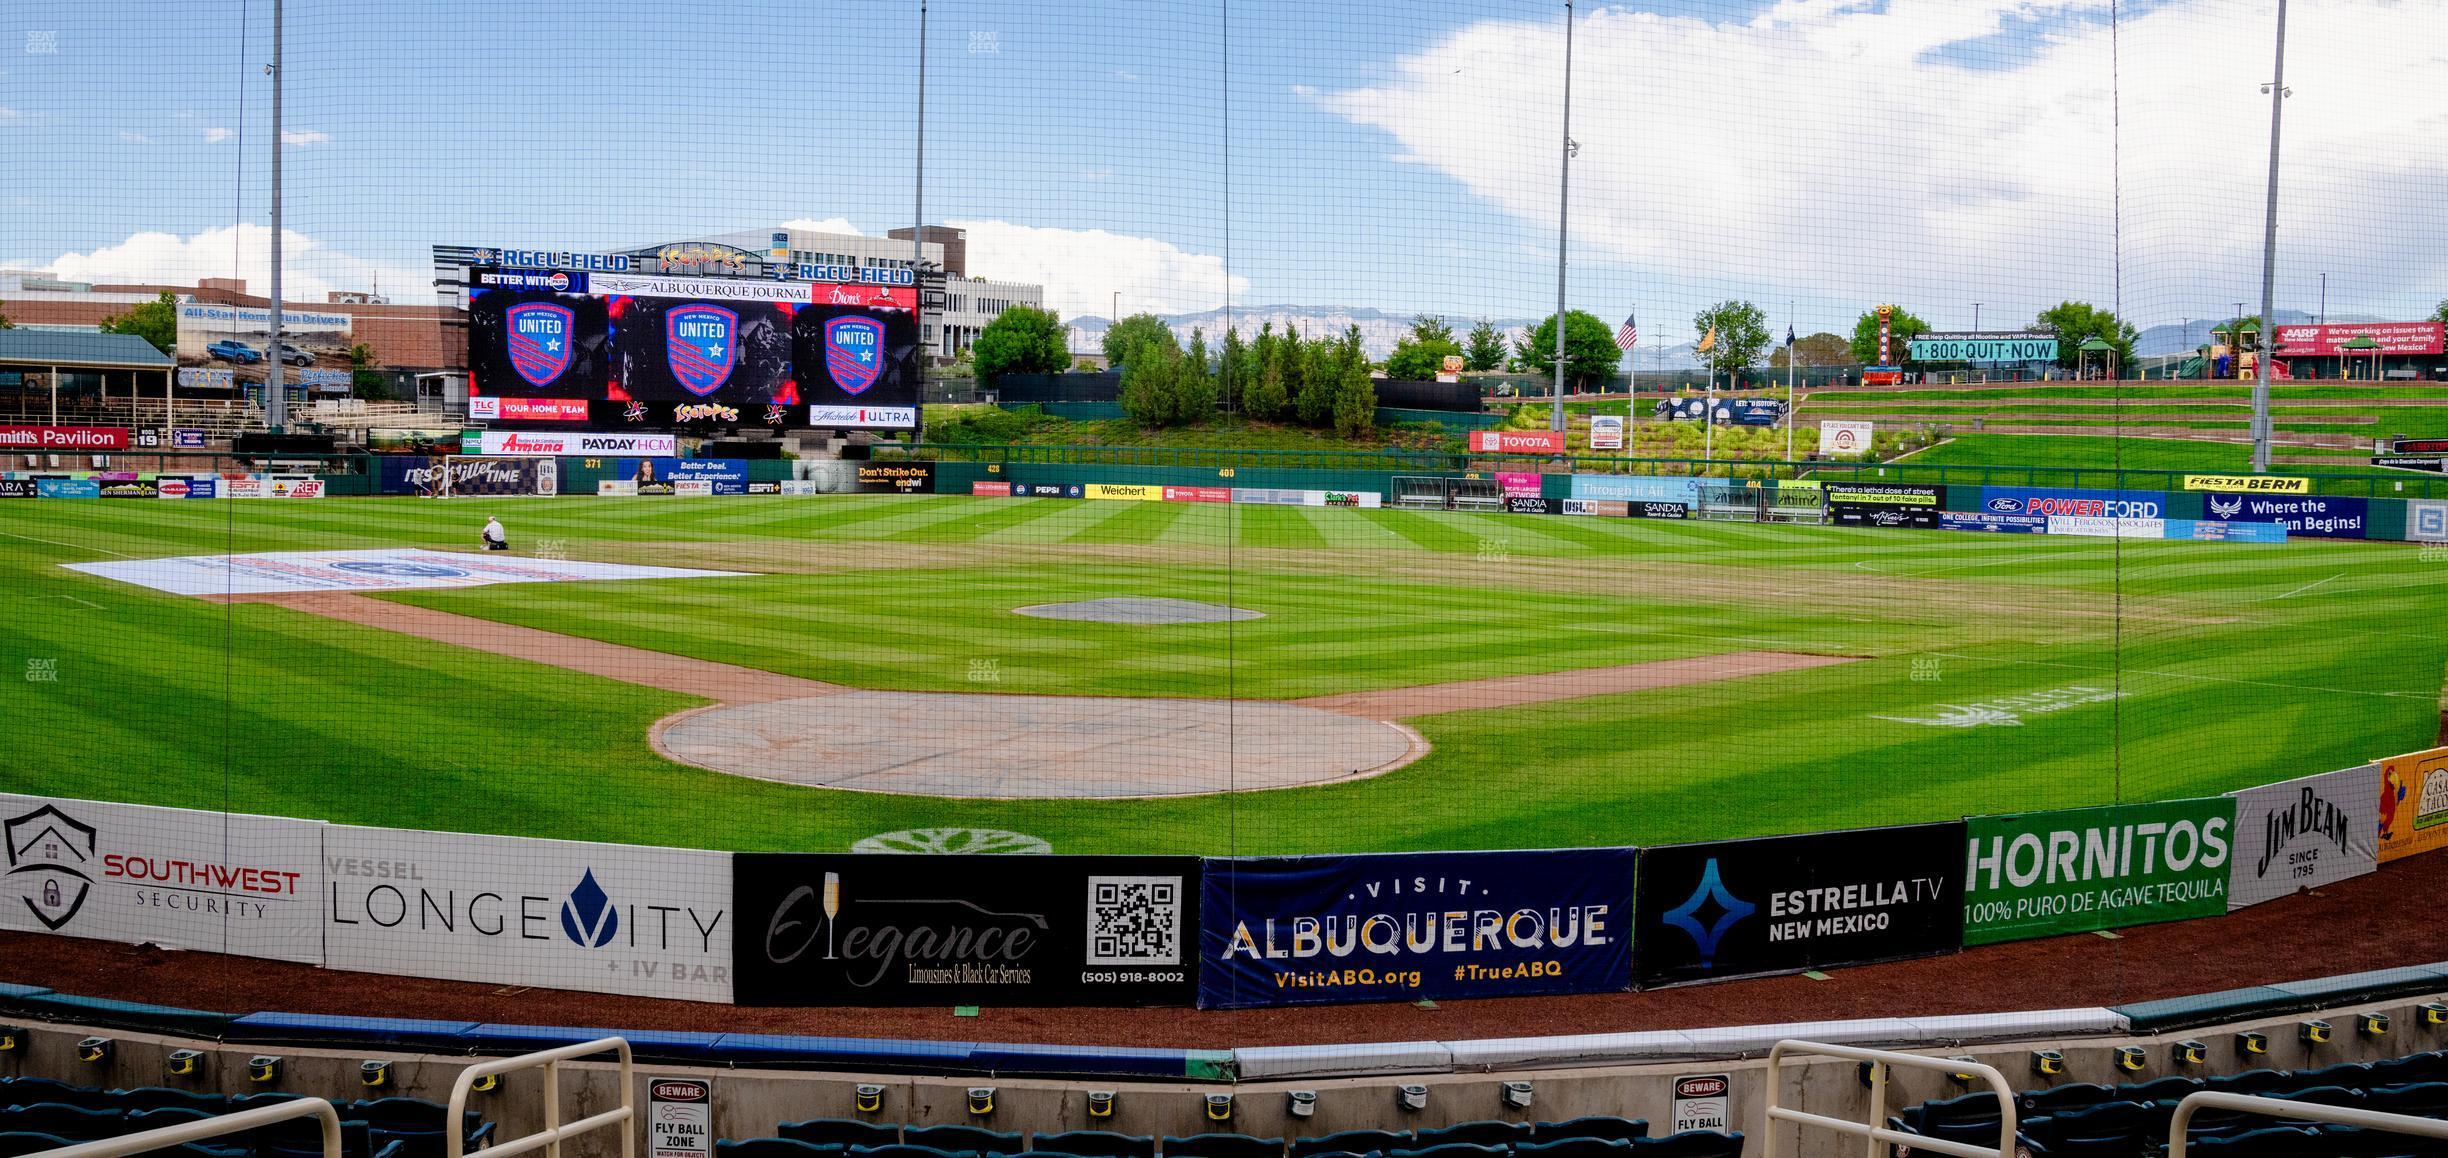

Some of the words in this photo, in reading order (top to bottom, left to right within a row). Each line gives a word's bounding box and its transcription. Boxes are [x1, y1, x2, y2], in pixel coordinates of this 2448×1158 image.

[502, 249, 563, 267] RGCU
[570, 252, 630, 271] FIELD
[481, 273, 524, 286] BETTER
[525, 274, 552, 287] WITH
[797, 263, 852, 281] RGCU
[859, 267, 914, 285] FIELD
[650, 282, 750, 297] ALBUQUERQUE
[752, 287, 810, 299] JOURNAL
[829, 285, 861, 305] Dion's
[184, 307, 235, 320] All-Star
[302, 314, 348, 326] Drivers
[519, 319, 562, 334] UNITED
[680, 322, 725, 338] UNITED
[2285, 328, 2319, 338] AARP
[2351, 327, 2381, 336] working
[836, 330, 874, 345] UNITED
[2392, 336, 2407, 344] your
[2408, 334, 2436, 344] family
[2398, 343, 2426, 351] Mexico!
[300, 369, 352, 386] Perfection
[474, 401, 494, 409] TLC
[505, 404, 529, 413] YOUR
[532, 405, 558, 413] HOME
[561, 405, 585, 414] TEAM
[814, 410, 857, 421] Michelob
[868, 412, 911, 423] ULTRA
[43, 430, 114, 445] Pavilion
[139, 435, 157, 446] 19
[501, 434, 564, 452] Amana
[1503, 437, 1551, 448] TOYOTA
[582, 438, 636, 450] PAYDAY
[637, 439, 673, 451] HCM
[585, 458, 600, 469] 371
[680, 462, 706, 470] Better
[707, 462, 727, 470] Deal.
[987, 464, 1000, 473] 428
[486, 469, 520, 482] TIME
[668, 472, 693, 480] Better
[859, 467, 882, 477] Don't
[884, 468, 909, 477] Strike
[910, 468, 929, 477] Out.
[1218, 468, 1235, 478] 400
[297, 482, 319, 492] RED
[1035, 486, 1060, 495] PEPSI
[2190, 478, 2244, 486] FIESTA
[2247, 479, 2302, 490] BERM
[1101, 485, 1146, 497] Weichert
[1583, 484, 1631, 498] Through
[1635, 484, 1643, 496] it
[1511, 498, 1547, 508] SANDIA
[1644, 502, 1684, 513] SANDIA
[1994, 500, 2017, 511] Ford
[2250, 501, 2298, 514] Where
[2301, 500, 2326, 513] the
[1981, 515, 2004, 523] INFINITE
[2006, 515, 2045, 524] POSSIBILITIES
[2305, 516, 2361, 534] Begins!
[2258, 803, 2297, 879] JIM
[2298, 786, 2349, 857] BEAM
[1965, 816, 2229, 892] HORNITOS
[2289, 848, 2318, 866] SINCE
[103, 853, 301, 895] SOUTHWEST
[326, 856, 423, 882] VESSEL
[2292, 864, 2314, 879] 1795
[1366, 877, 1471, 898] VISIT
[136, 890, 267, 919] SECURITY
[1964, 901, 2012, 924] 100%
[2016, 894, 2067, 919] PURO
[2071, 891, 2094, 912] DE
[2098, 885, 2153, 910] AGAVE
[2156, 878, 2223, 903] TEQUILA
[765, 878, 1039, 987] Elegance
[1769, 920, 1811, 942] NEW
[1817, 912, 1889, 936] MEXICO
[633, 960, 658, 979] IV
[672, 963, 728, 984] BAR
[908, 963, 953, 985] Limousines
[954, 965, 961, 984] &
[962, 964, 983, 984] Black
[984, 965, 999, 985] Car
[1000, 965, 1032, 985] Services
[1081, 971, 1118, 984] (505)
[1120, 971, 1185, 983] 918-8002
[1274, 968, 1421, 988] VisitABQ.org
[1454, 960, 1562, 982] #TrueABQ
[659, 1086, 700, 1097] BEWARE
[1683, 1081, 1721, 1093] BEWARE
[656, 1123, 675, 1135] FLY
[678, 1123, 704, 1135] BALL
[1678, 1119, 1695, 1130] FLY
[1698, 1117, 1723, 1128] BALL
[666, 1136, 695, 1148] ZONE
